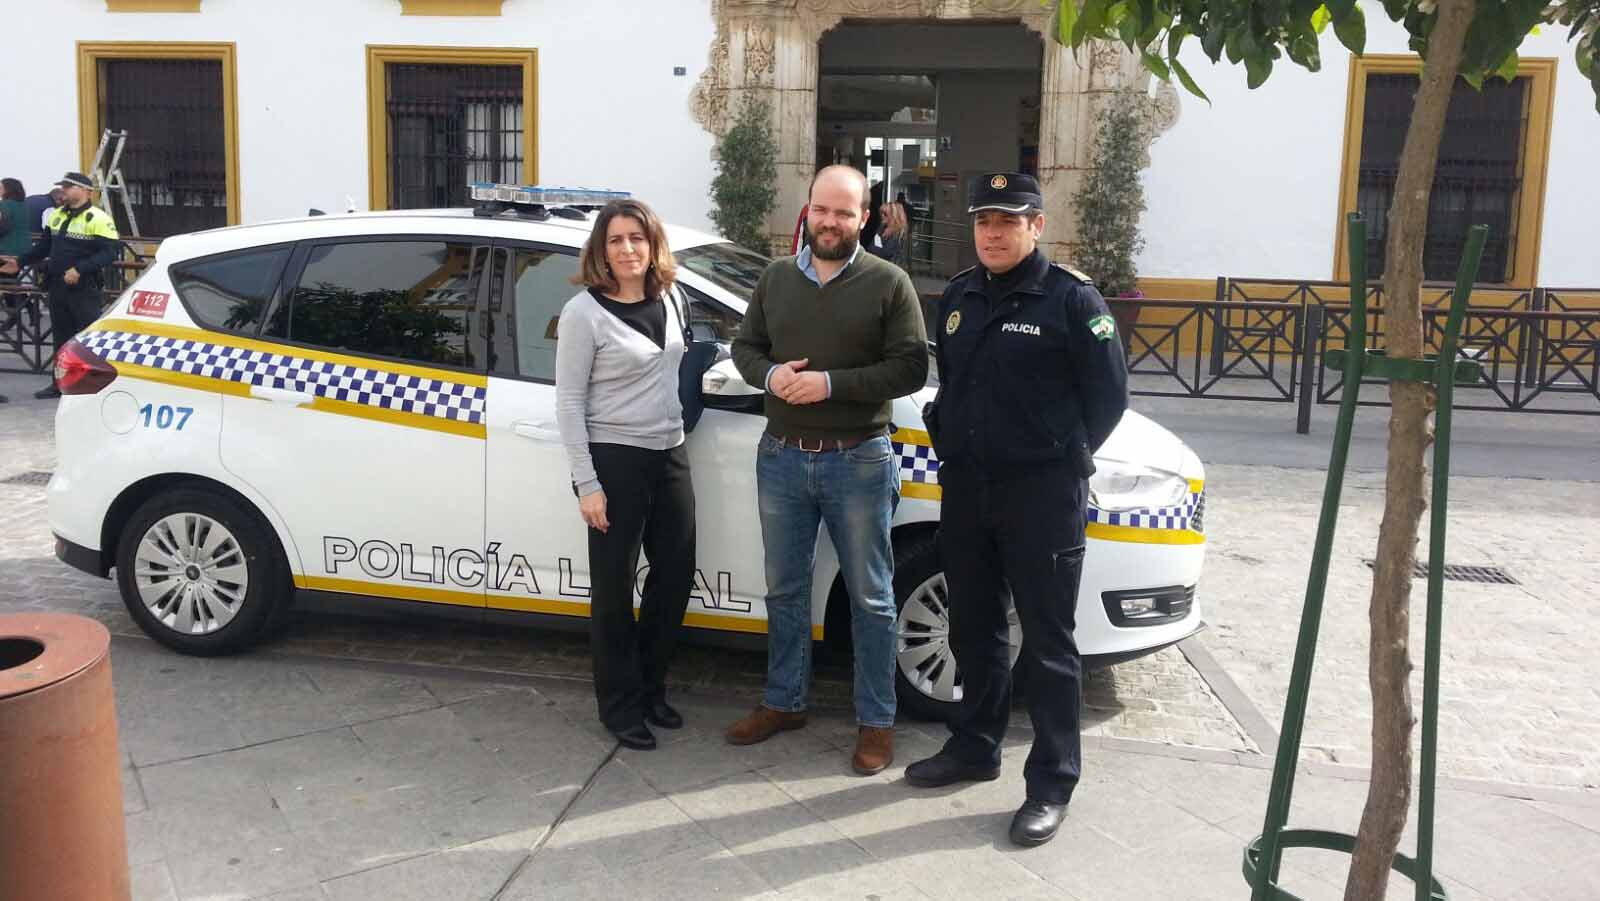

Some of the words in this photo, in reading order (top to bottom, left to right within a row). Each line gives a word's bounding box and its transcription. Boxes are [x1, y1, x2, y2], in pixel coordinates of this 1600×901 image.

[144, 294, 164, 306] 112
[1001, 322, 1041, 336] POLICIA
[140, 403, 194, 431] 107
[323, 535, 542, 595] POLICÍA
[558, 557, 752, 613] LAL
